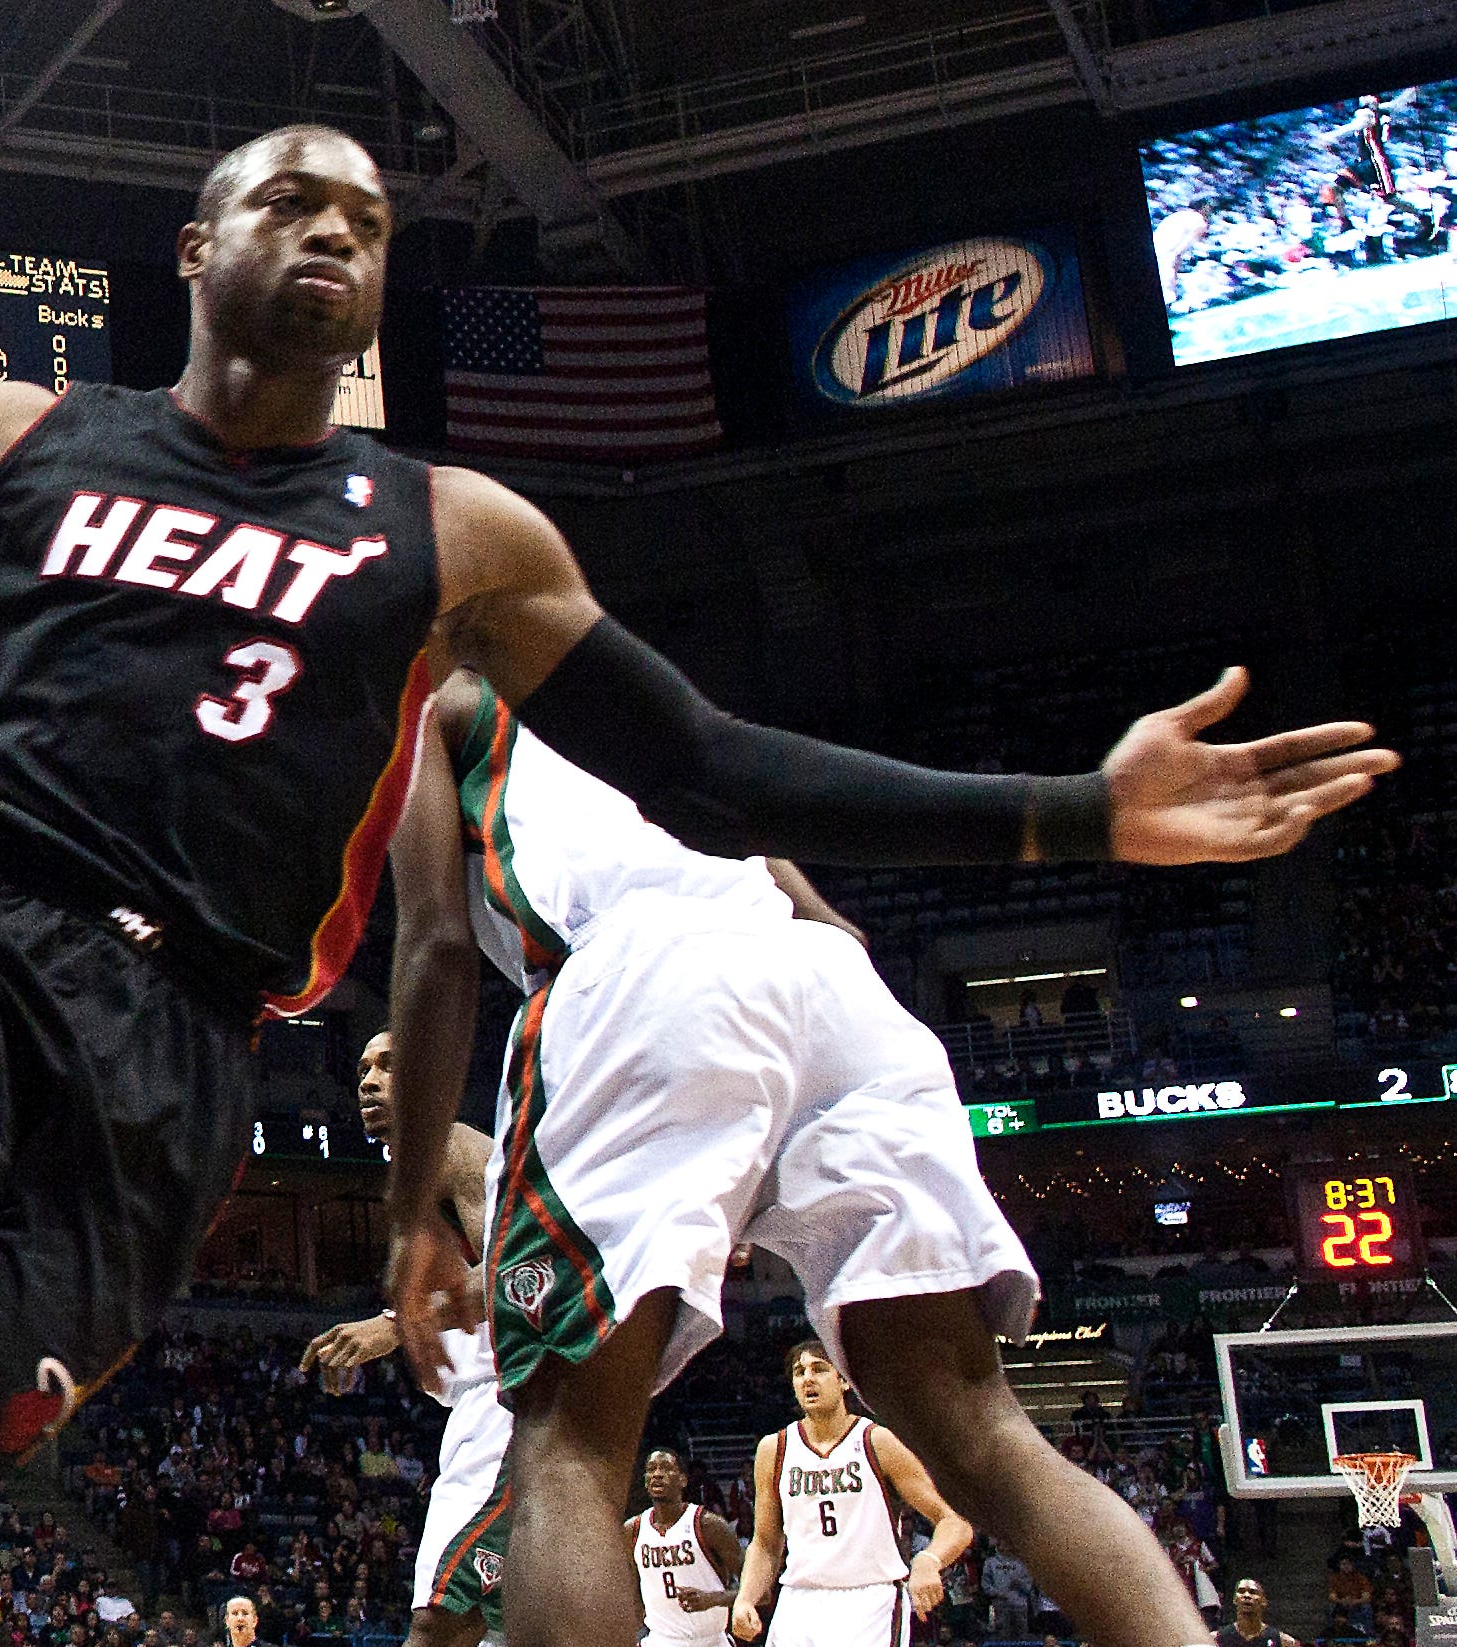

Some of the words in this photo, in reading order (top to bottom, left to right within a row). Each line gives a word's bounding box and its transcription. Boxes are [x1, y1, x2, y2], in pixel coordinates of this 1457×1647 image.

[10, 255, 77, 279] TEAM
[876, 258, 988, 319] Miller
[38, 304, 104, 329] Bucks
[52, 334, 66, 353] 0
[53, 356, 68, 375] 0
[41, 490, 389, 628] HEAT
[192, 635, 304, 746] 3
[1097, 1080, 1247, 1119] BUCKS
[1377, 1067, 1413, 1102] 2
[1324, 1176, 1396, 1210] 8:37
[1320, 1211, 1394, 1267] 22
[787, 1461, 863, 1497] BUCKS
[819, 1500, 839, 1537] 6
[641, 1540, 696, 1569] BUCKS
[662, 1571, 677, 1600] 8
